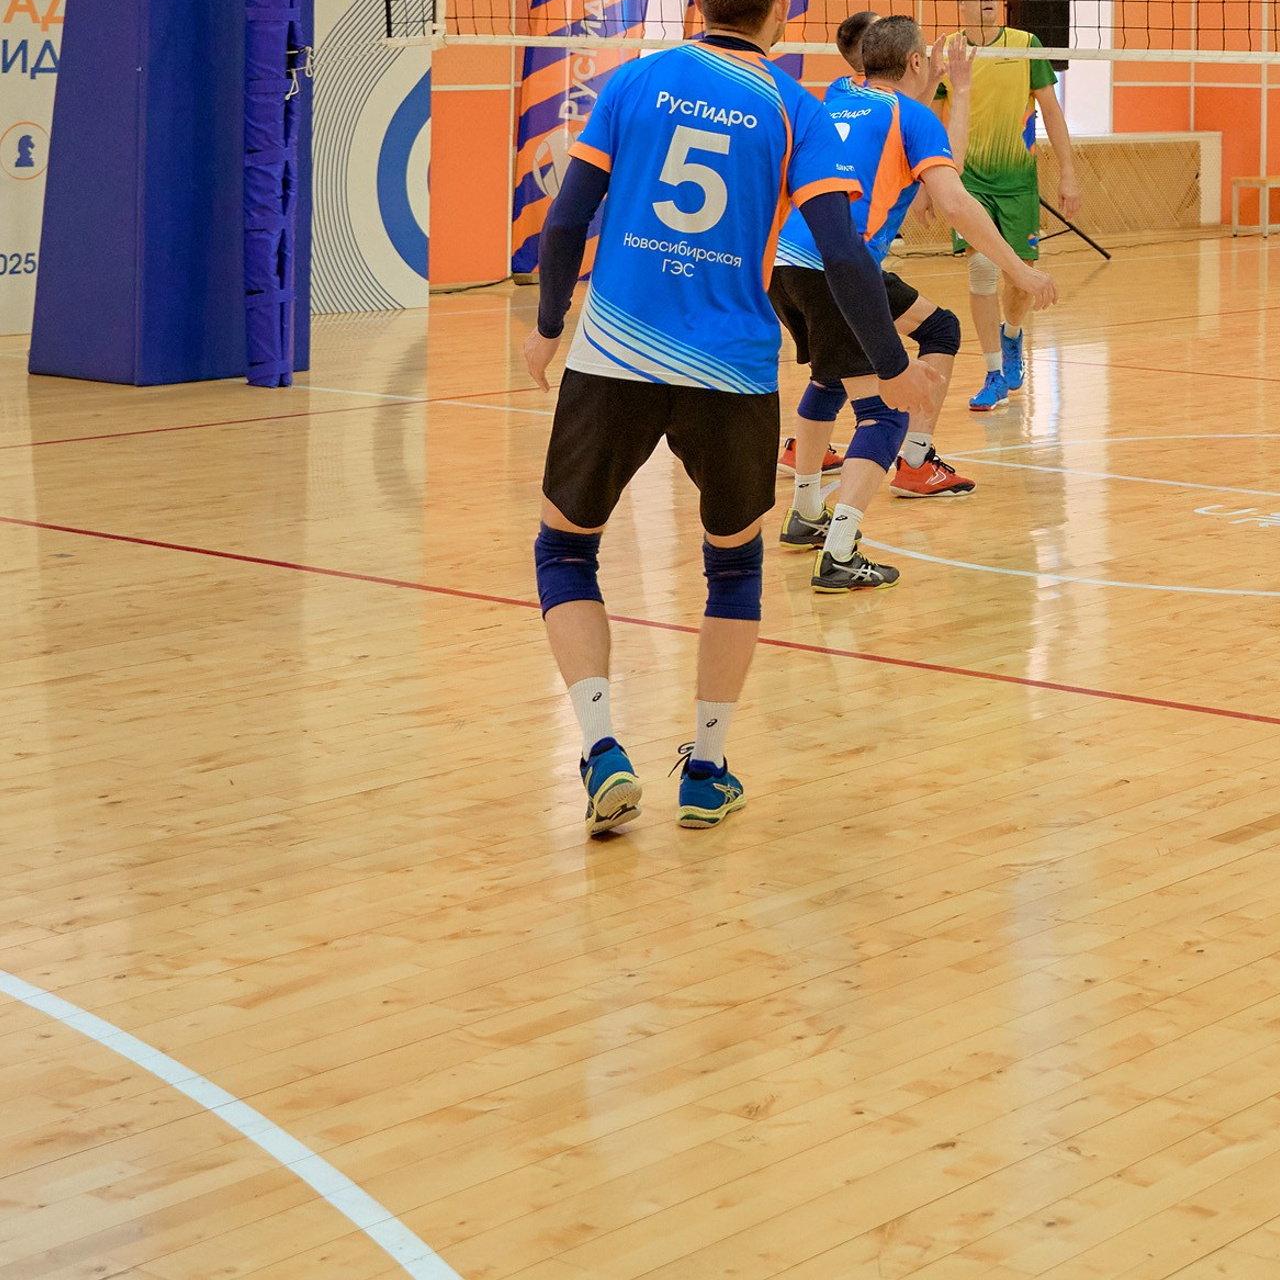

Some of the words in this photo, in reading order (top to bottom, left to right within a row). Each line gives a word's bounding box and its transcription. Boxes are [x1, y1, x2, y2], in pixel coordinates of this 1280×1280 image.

[655, 90, 758, 129] РусГидро
[652, 124, 730, 234] 5
[623, 232, 742, 268] Новосибирская
[662, 258, 695, 278] ГЭС
